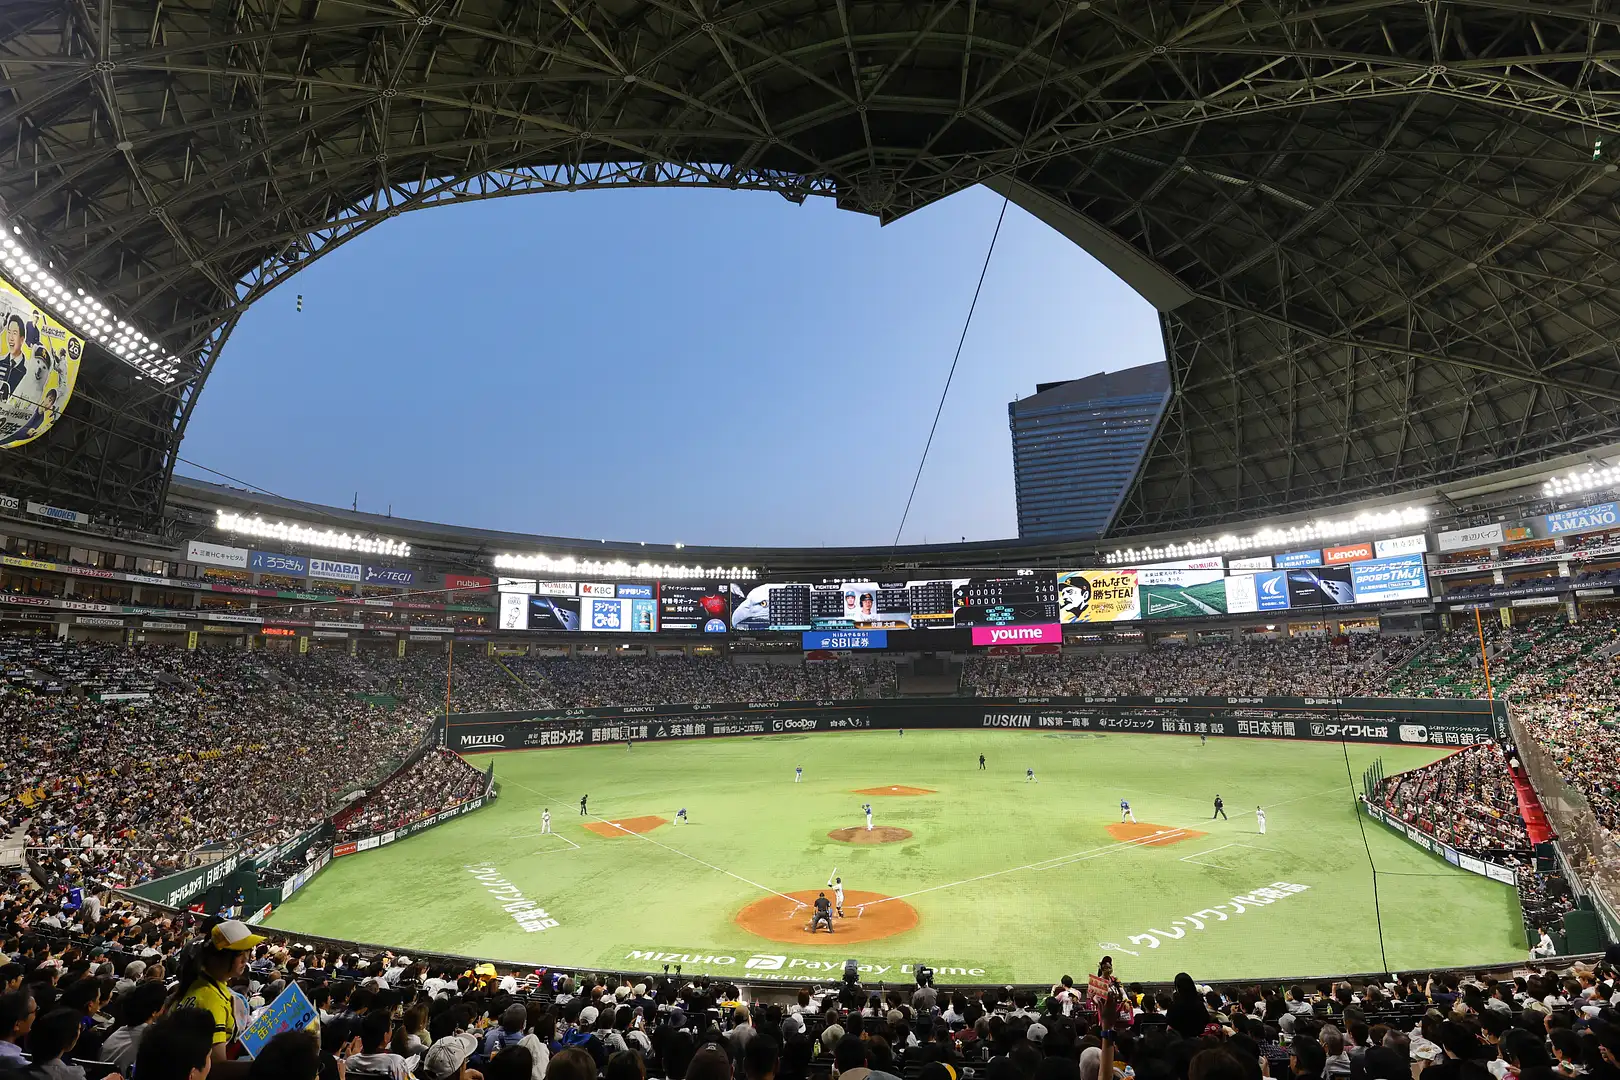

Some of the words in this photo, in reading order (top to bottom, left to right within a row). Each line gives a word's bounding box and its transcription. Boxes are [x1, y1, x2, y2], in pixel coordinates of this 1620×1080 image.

[47, 508, 76, 521] ONOKEN
[1551, 512, 1616, 532] AMANO
[200, 550, 245, 562] 三菱HCキャピタル
[1328, 549, 1368, 560] Lenovo
[267, 556, 304, 571] ろうきん
[321, 562, 360, 575] INABA
[1188, 561, 1219, 569] NOMURA
[1092, 577, 1130, 587] みんなで
[594, 586, 612, 594] KBC
[1093, 587, 1133, 600] 勝ちTEA!
[991, 628, 1042, 642] youme
[832, 638, 869, 647] SBI証券
[670, 724, 706, 736] 英進館
[785, 719, 817, 729] GooDay
[1108, 719, 1154, 728] エイジェック
[1162, 722, 1224, 734] 昭和建設
[1238, 720, 1296, 736] 西日本新聞
[541, 729, 584, 745] 武田メガネ
[592, 726, 648, 741] 西部電気工業
[1326, 724, 1388, 738] ダイワ化成
[461, 734, 504, 745] MIZUHO
[1429, 731, 1489, 745] 福岡銀行
[1128, 881, 1312, 948] クレソワン化粧品
[624, 950, 736, 965] MIZUHO
[900, 964, 986, 977] Dme
